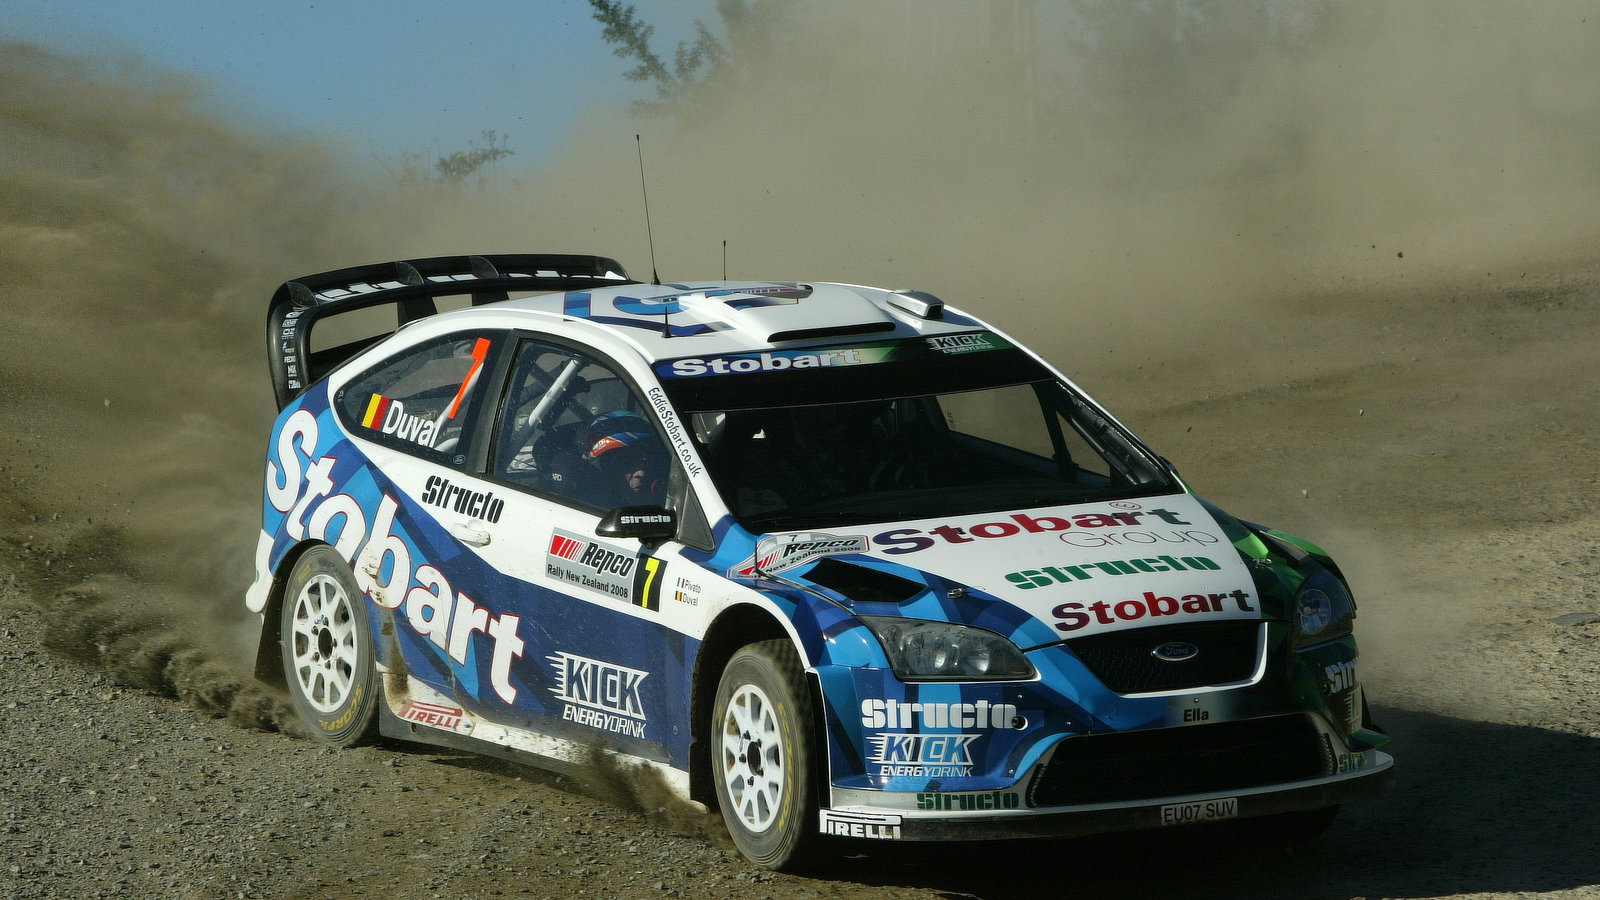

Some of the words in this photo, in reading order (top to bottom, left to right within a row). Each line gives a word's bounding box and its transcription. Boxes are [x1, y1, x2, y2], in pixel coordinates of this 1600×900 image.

[927, 334, 992, 351] KICK
[448, 337, 491, 419] 7
[672, 349, 862, 376] Stobart
[382, 400, 440, 448] Duval
[648, 387, 702, 478] EddieStobart.co.uk
[421, 475, 505, 524] Structo
[872, 508, 1192, 555] Stobart
[1059, 530, 1219, 548] Group
[264, 408, 525, 706] Stobart
[579, 541, 635, 577] Repco
[782, 539, 860, 559] Repco
[789, 548, 830, 563] Zealand
[547, 564, 565, 579] Rally
[565, 569, 581, 583] New
[582, 574, 610, 592] Zealand
[610, 583, 629, 598] 2008
[641, 557, 660, 608] 7
[1004, 554, 1222, 590] Structo
[682, 593, 699, 607] Duval
[1051, 588, 1255, 632] Stobart
[550, 651, 649, 720] KICK
[399, 698, 463, 729] PIRELLI
[861, 698, 1018, 729] Structo
[1183, 708, 1209, 722] Ella
[867, 733, 982, 765] KICK
[916, 791, 1020, 810] Structo
[1163, 804, 1201, 821] EU07
[1205, 800, 1235, 818] SUV
[819, 809, 903, 840] PIRELLI
